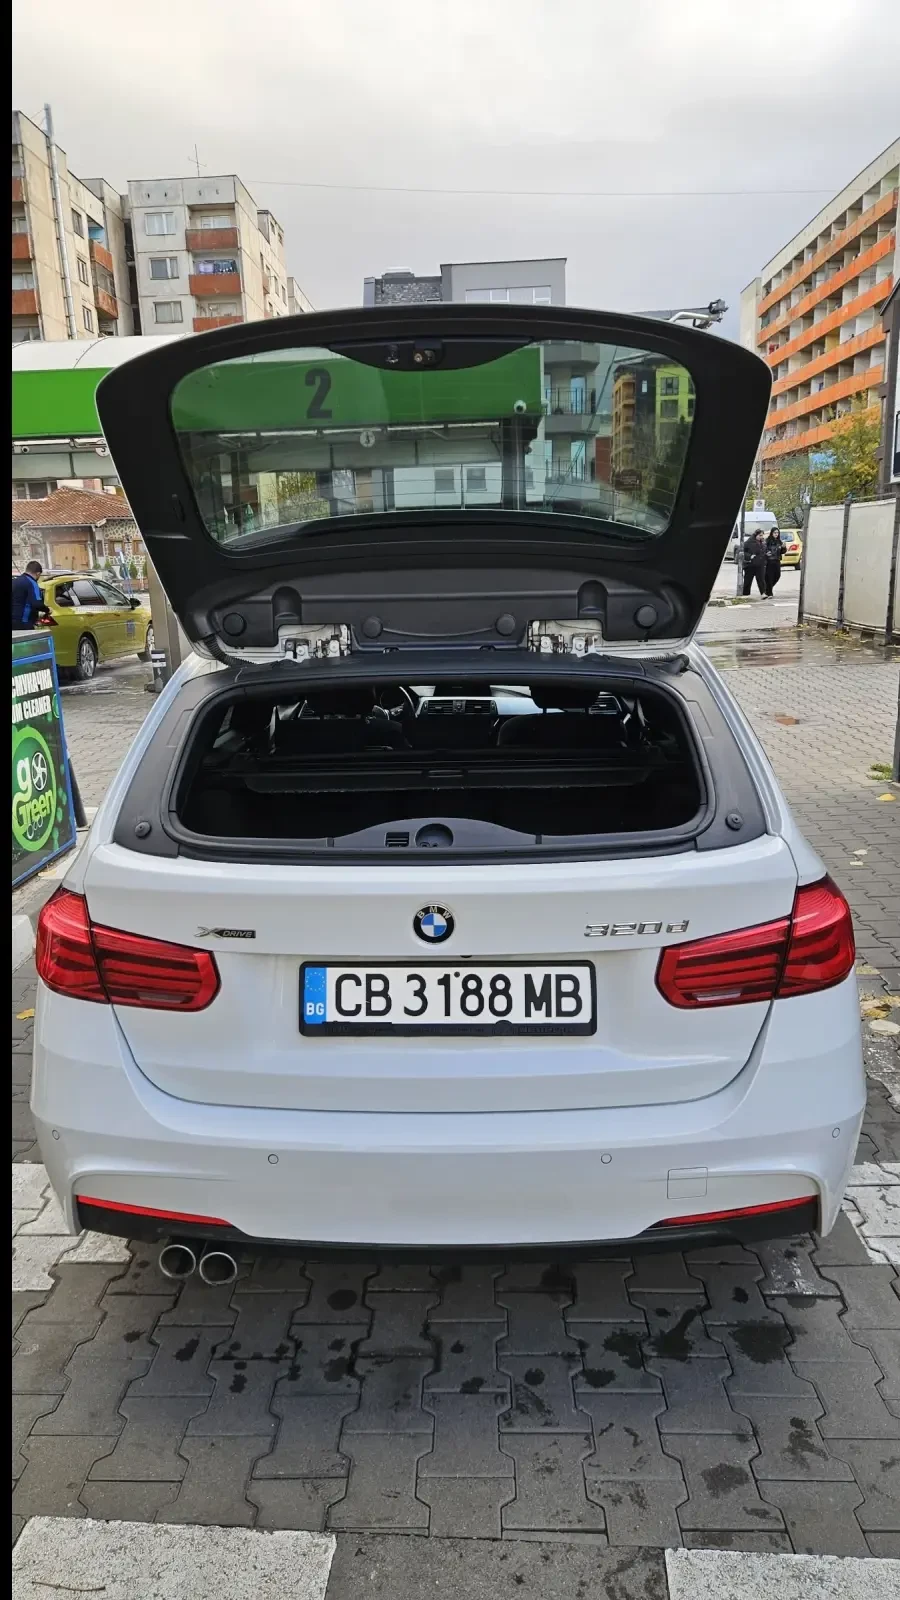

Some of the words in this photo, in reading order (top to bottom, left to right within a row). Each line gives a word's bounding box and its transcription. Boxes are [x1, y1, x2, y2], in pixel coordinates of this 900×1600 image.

[305, 368, 332, 419] 2
[22, 695, 52, 719] CLEANER
[12, 789, 53, 833] Green
[417, 906, 452, 919] BMW
[306, 1003, 325, 1016] BG
[335, 973, 392, 1017] CB
[404, 973, 513, 1017] 3188
[524, 973, 582, 1017] MB
